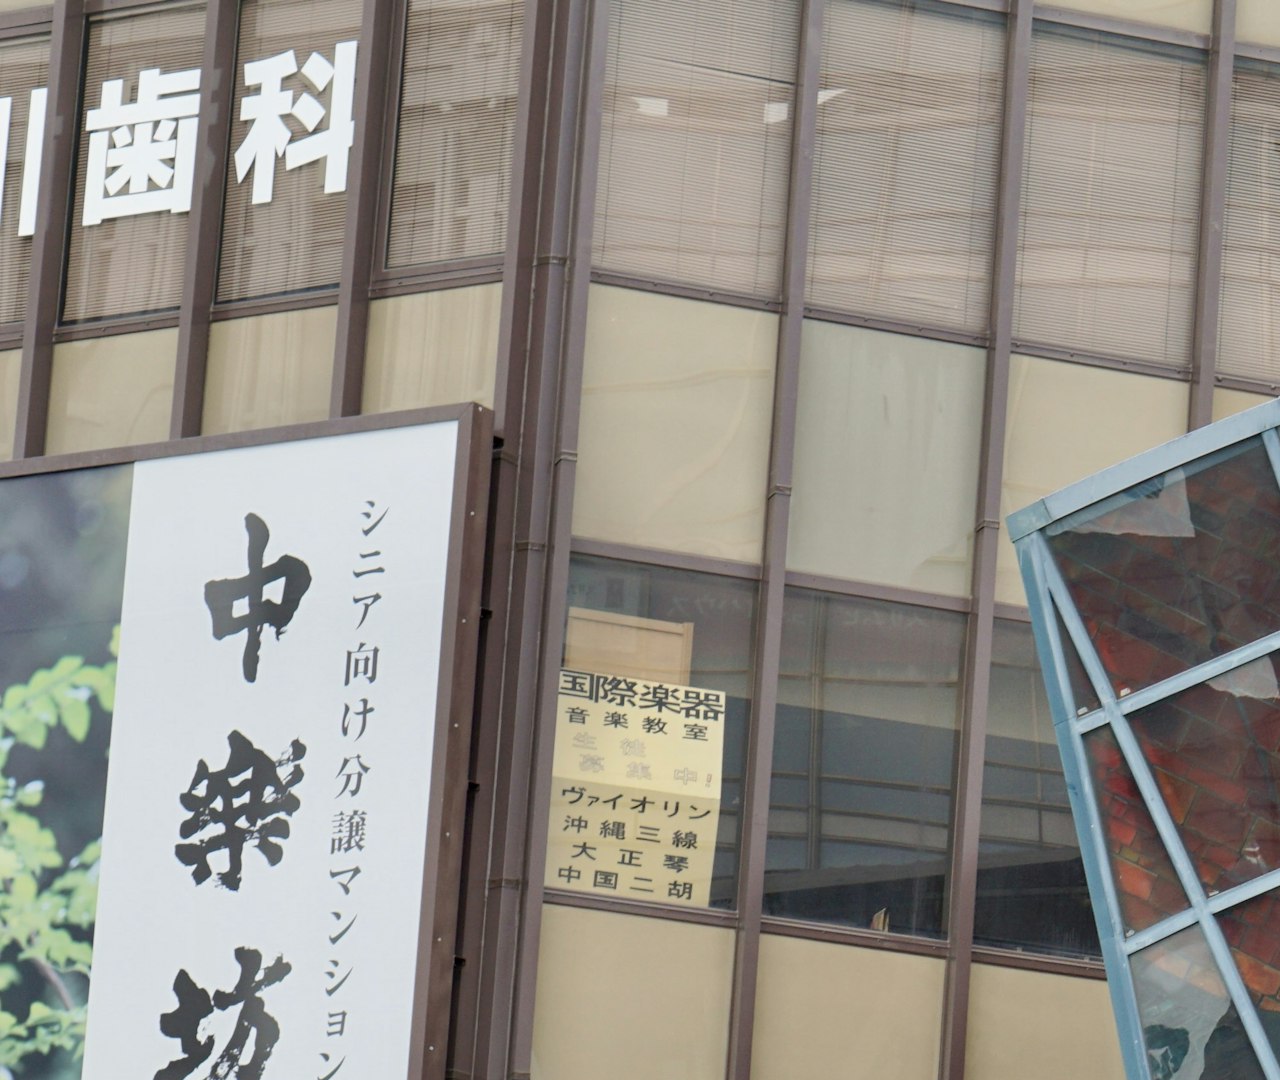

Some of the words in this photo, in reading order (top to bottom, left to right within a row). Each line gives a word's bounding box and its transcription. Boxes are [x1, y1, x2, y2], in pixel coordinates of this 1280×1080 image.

[557, 668, 726, 721] 国際楽器
[565, 707, 709, 741] 音楽教室
[562, 786, 710, 820] ヴァイオリン
[563, 815, 698, 849] 沖縄三線
[571, 841, 688, 873] 大正琴
[558, 865, 692, 900] 中国二胡
